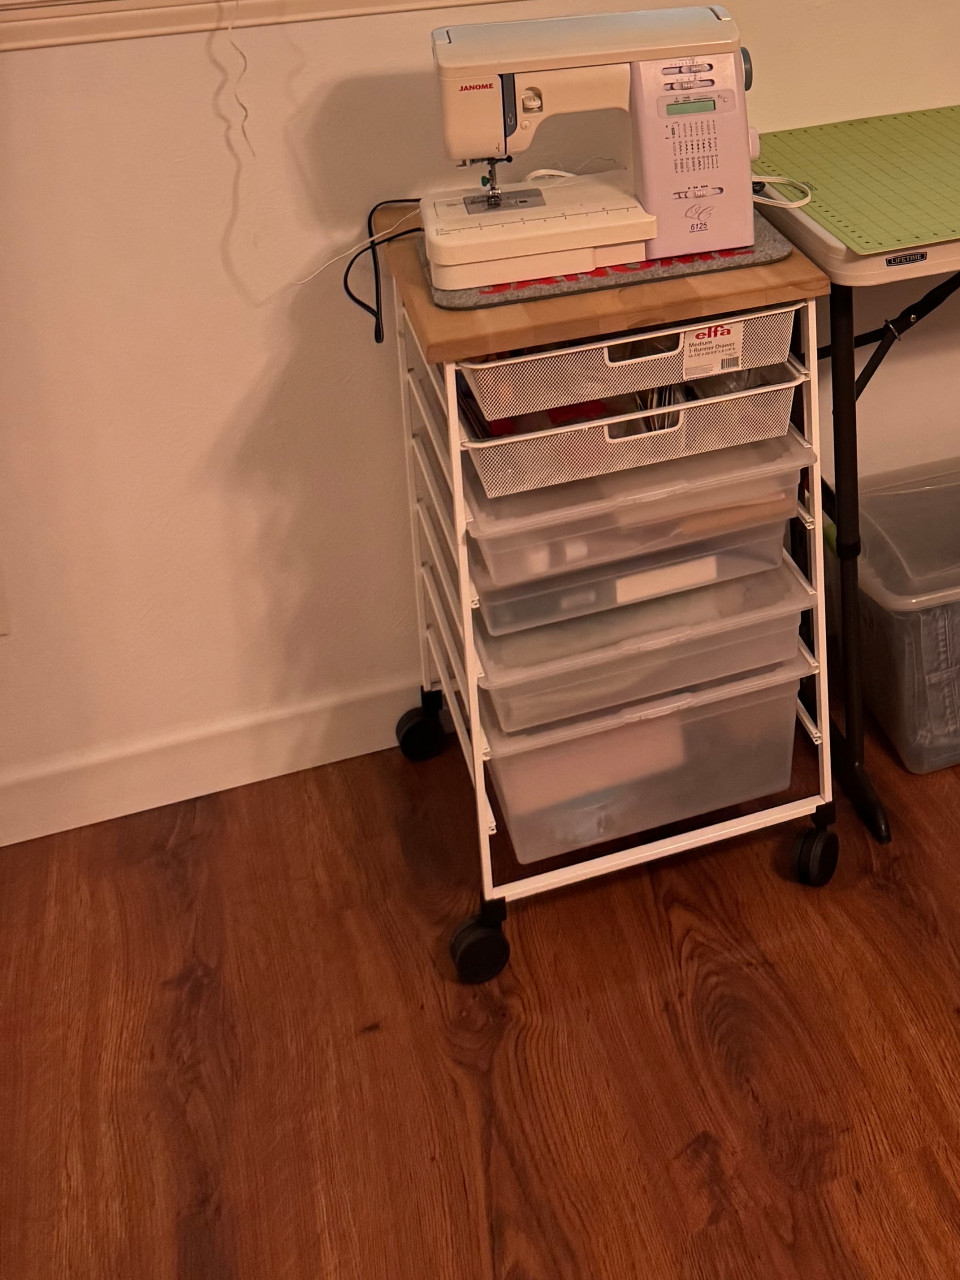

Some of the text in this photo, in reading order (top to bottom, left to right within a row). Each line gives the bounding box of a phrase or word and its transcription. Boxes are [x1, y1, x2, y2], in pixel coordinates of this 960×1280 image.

[459, 83, 494, 92] JANOME
[690, 222, 708, 231] 6125
[695, 325, 732, 340] elfa
[688, 340, 713, 348] Medium
